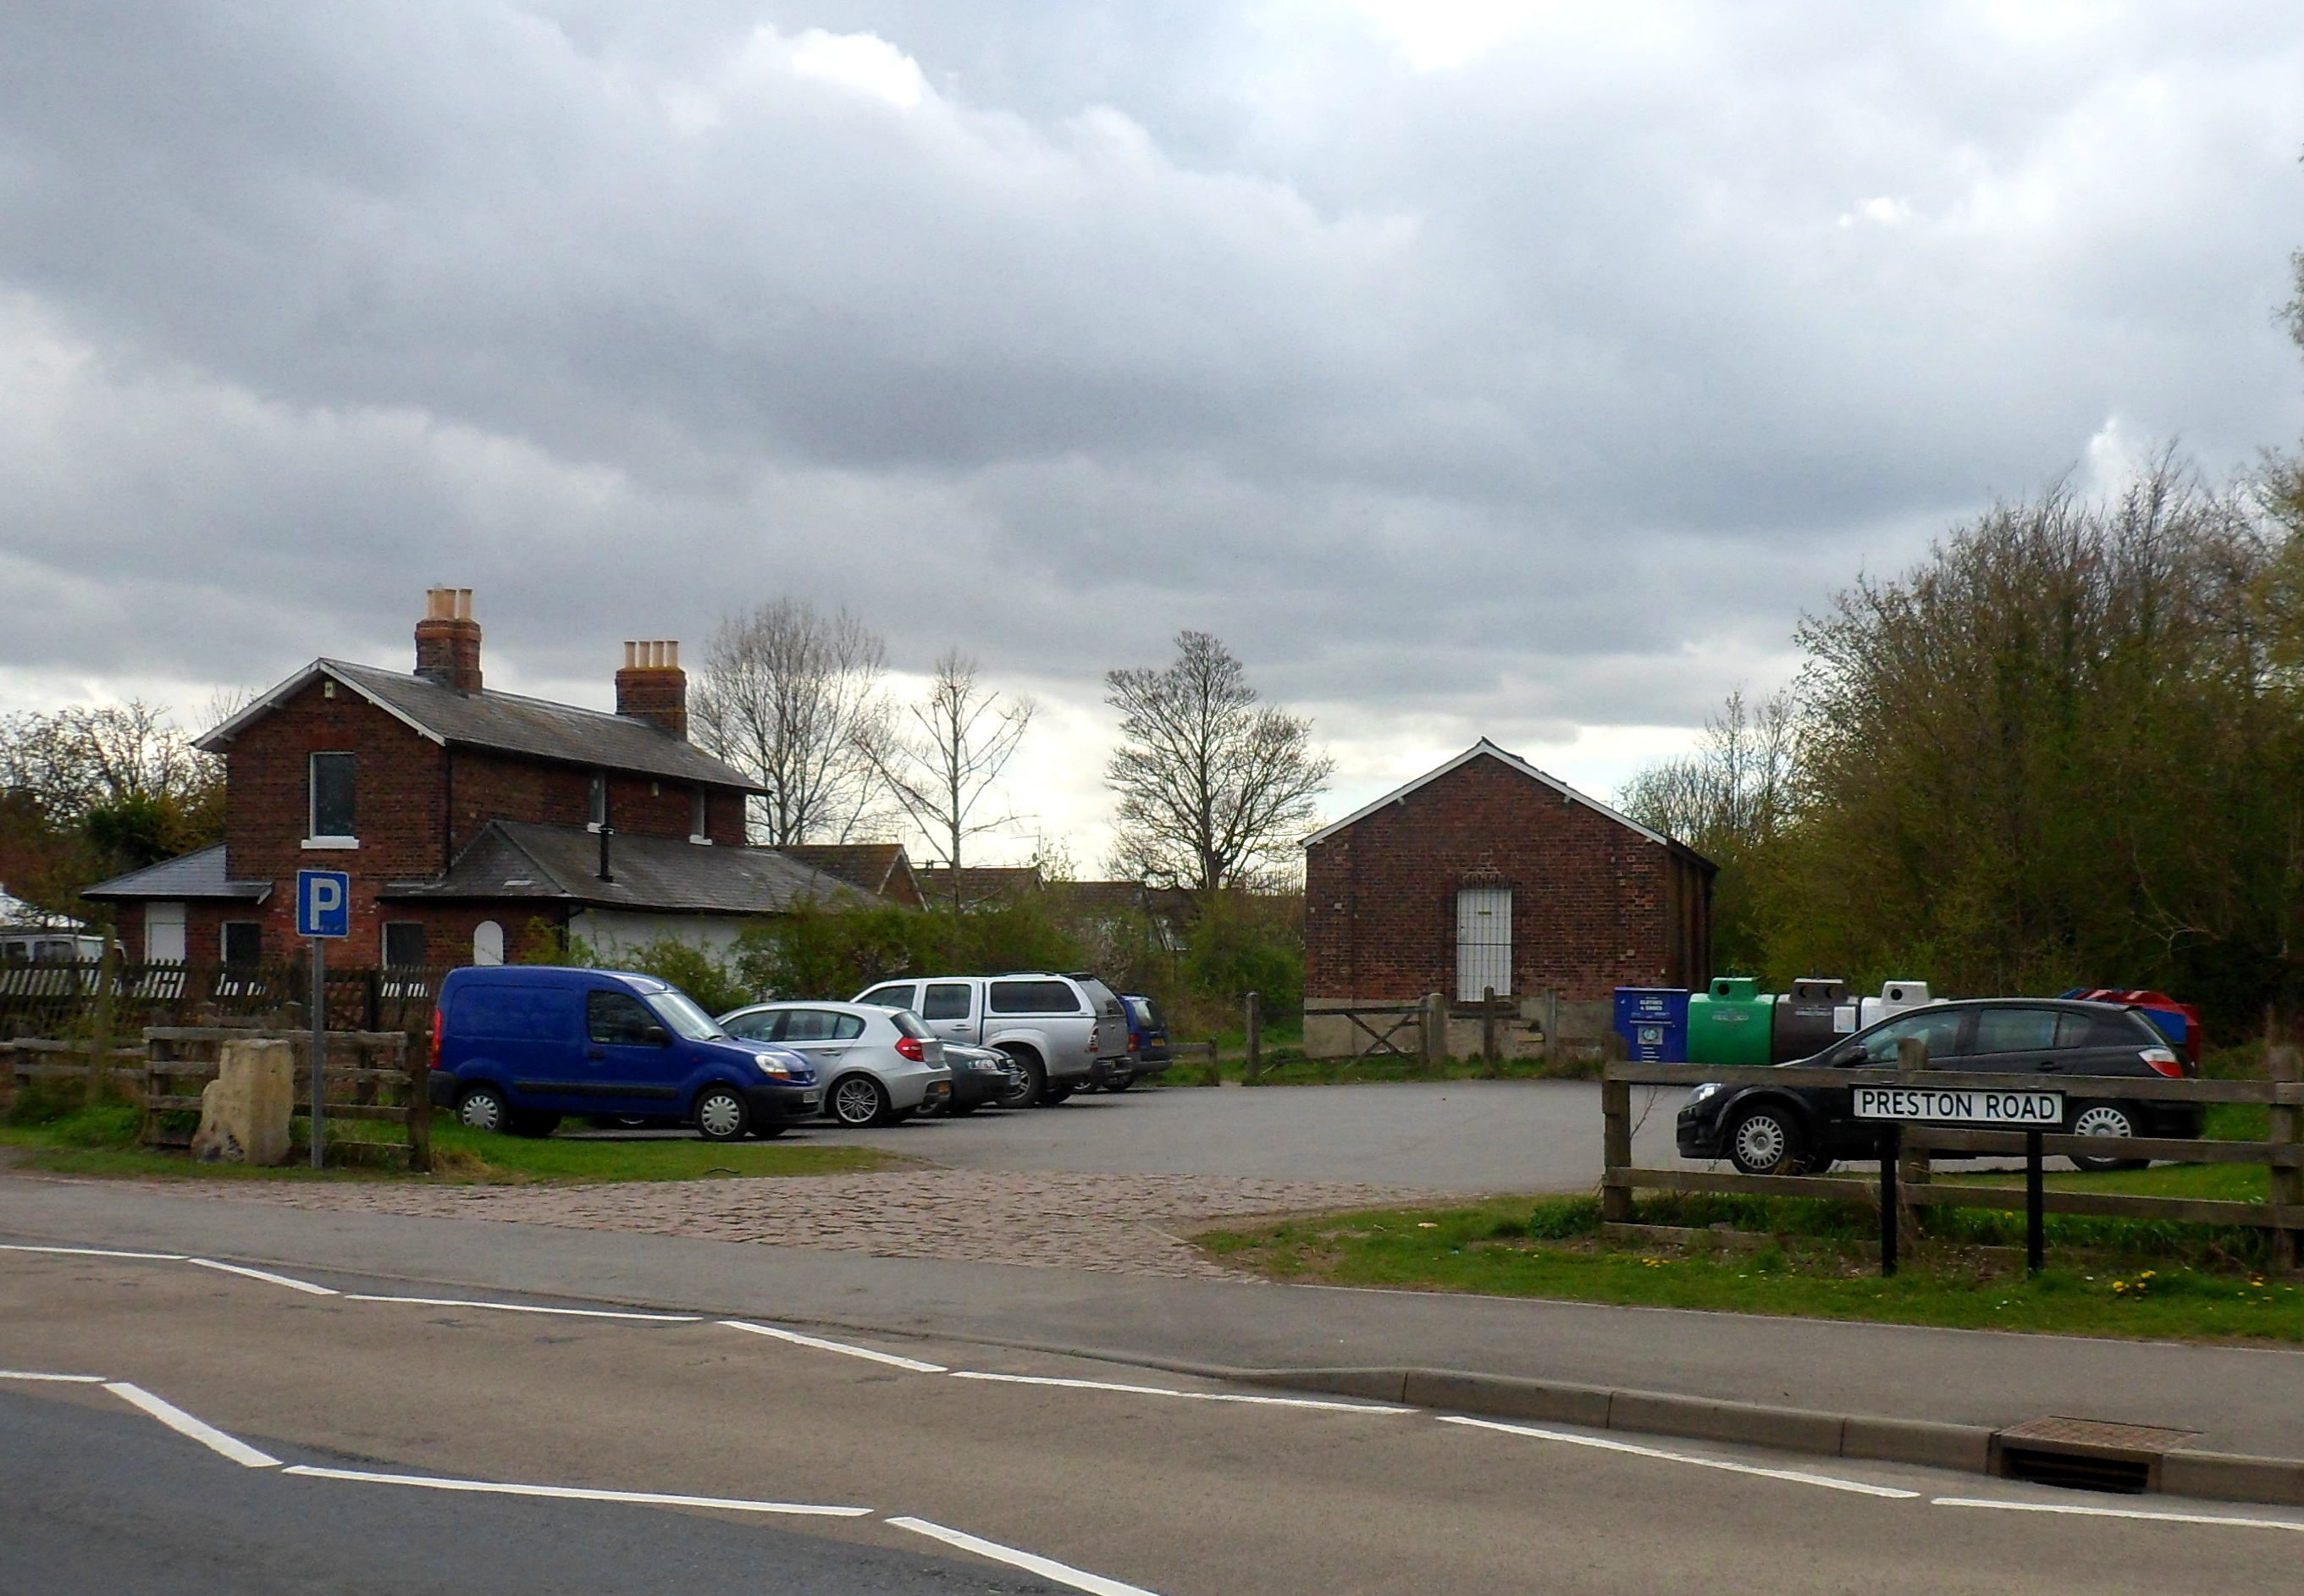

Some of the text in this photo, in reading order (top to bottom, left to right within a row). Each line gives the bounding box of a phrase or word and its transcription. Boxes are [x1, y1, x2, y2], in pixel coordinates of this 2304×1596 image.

[310, 877, 341, 931] P
[1861, 1091, 2055, 1119] PRESTON ROAD
